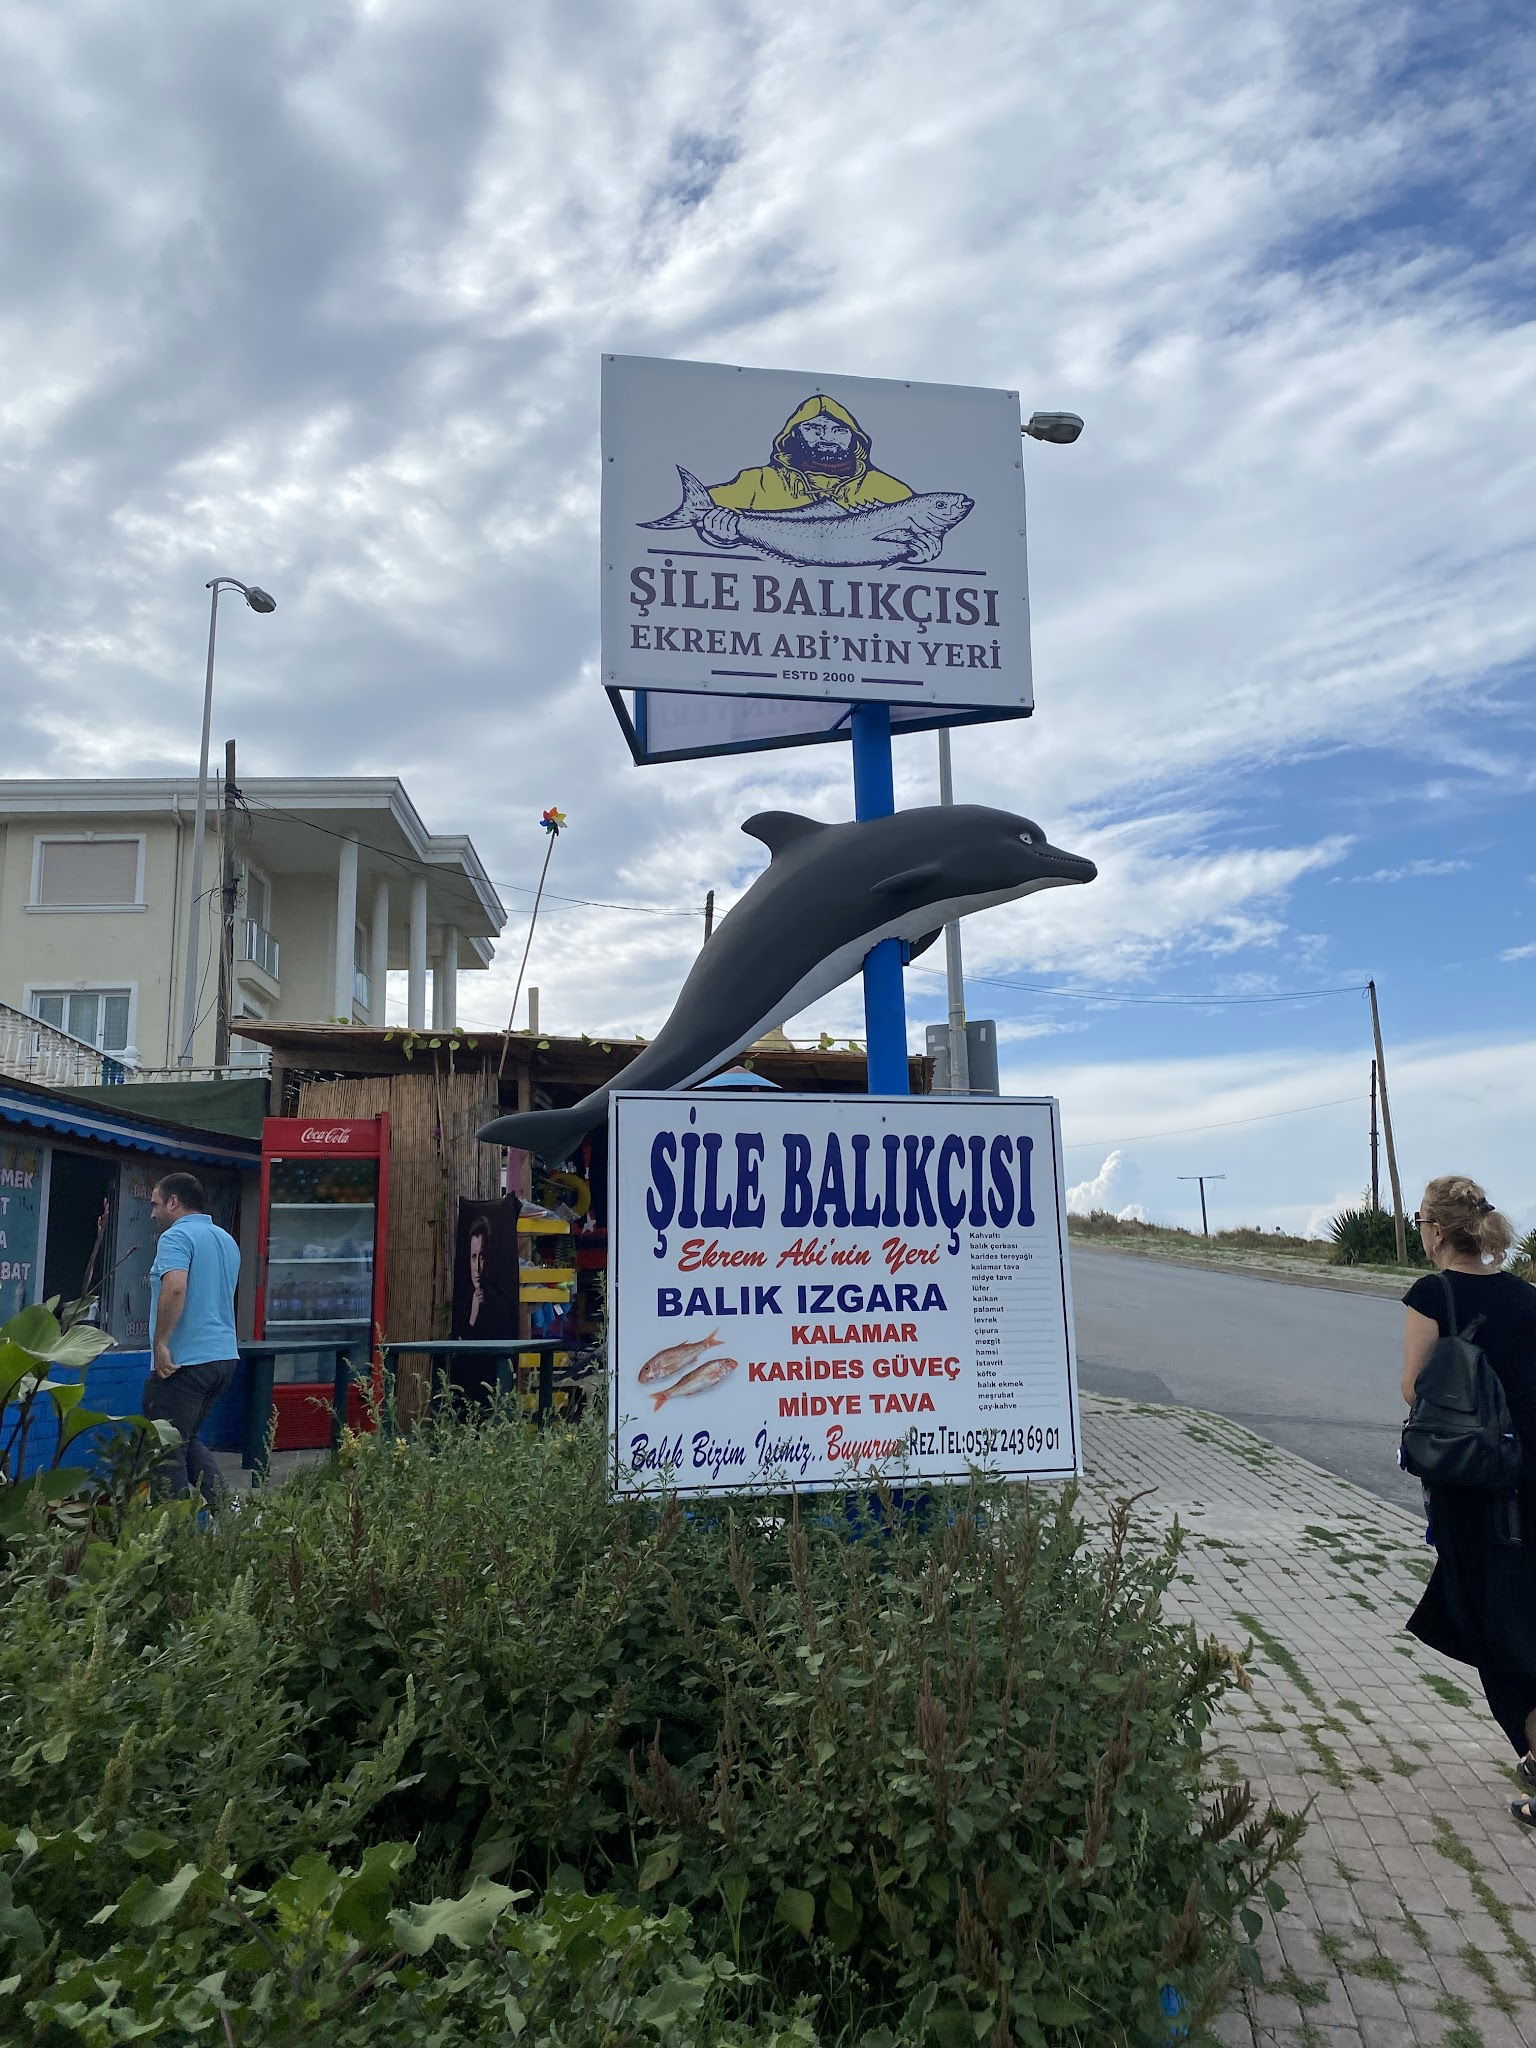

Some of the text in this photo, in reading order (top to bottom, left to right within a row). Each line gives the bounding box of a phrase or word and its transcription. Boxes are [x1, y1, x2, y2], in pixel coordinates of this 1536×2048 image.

[631, 558, 1000, 634] ŞİLE BALIKÇISI
[630, 624, 1001, 669] EKREM ABİ'NİN YERİ
[782, 670, 855, 683] ESTD 2000
[301, 1127, 352, 1144] Coca-Cola
[0, 1168, 33, 1190] MEK
[646, 1106, 1035, 1258] ŞİLE BALIKÇISI
[677, 1237, 941, 1275] Ekrem Abi'nin Yeri
[657, 1283, 948, 1317] BALIK IZGARA
[973, 1306, 1004, 1314] palamut
[791, 1323, 919, 1345] KALAMAR
[748, 1354, 961, 1382] KARİDES GÜVEÇ
[778, 1392, 936, 1417] MİDYE TAVA
[1000, 1428, 1024, 1455] 243
[1027, 1425, 1043, 1454] 69
[1046, 1427, 1059, 1450] 01
[692, 1430, 747, 1480] Bizim
